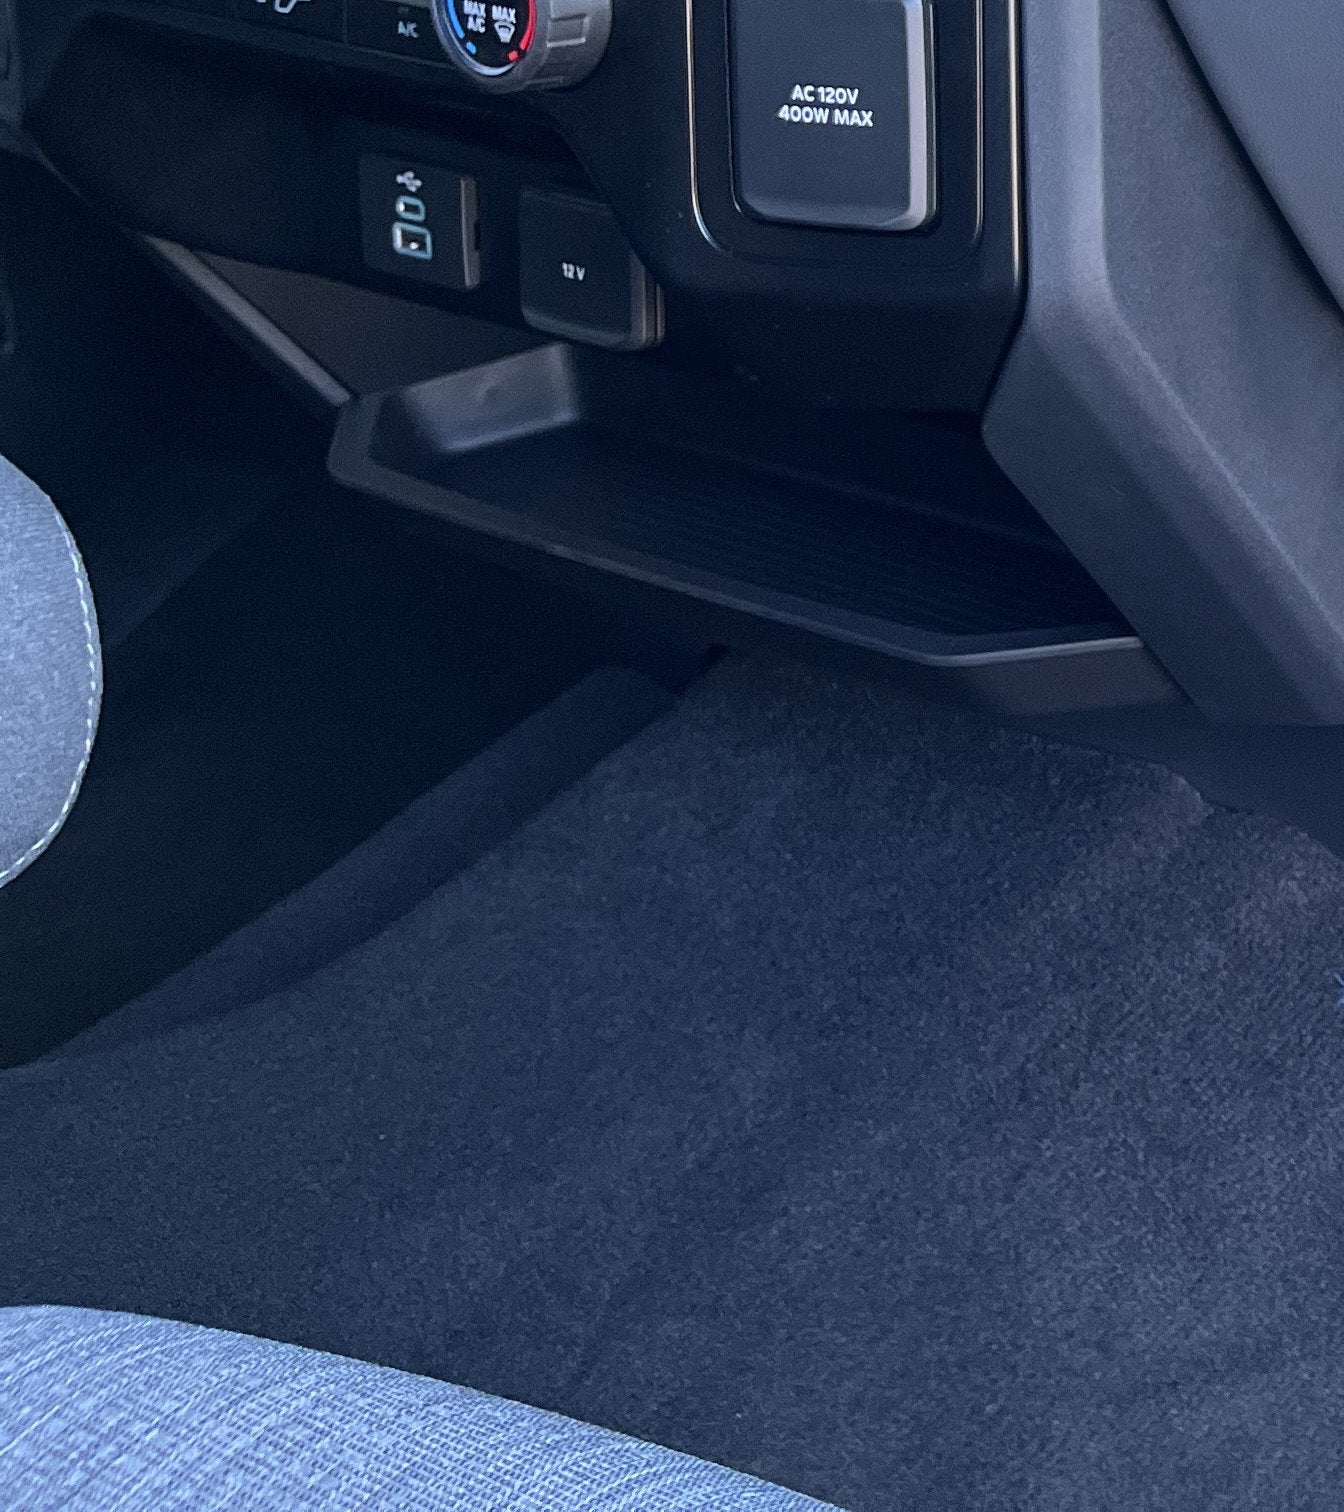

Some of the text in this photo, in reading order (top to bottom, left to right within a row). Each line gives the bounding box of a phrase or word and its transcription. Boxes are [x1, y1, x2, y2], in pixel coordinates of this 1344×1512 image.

[491, 4, 516, 24] MAX
[791, 84, 859, 105] AC 120V
[778, 104, 874, 127] 400W MAX
